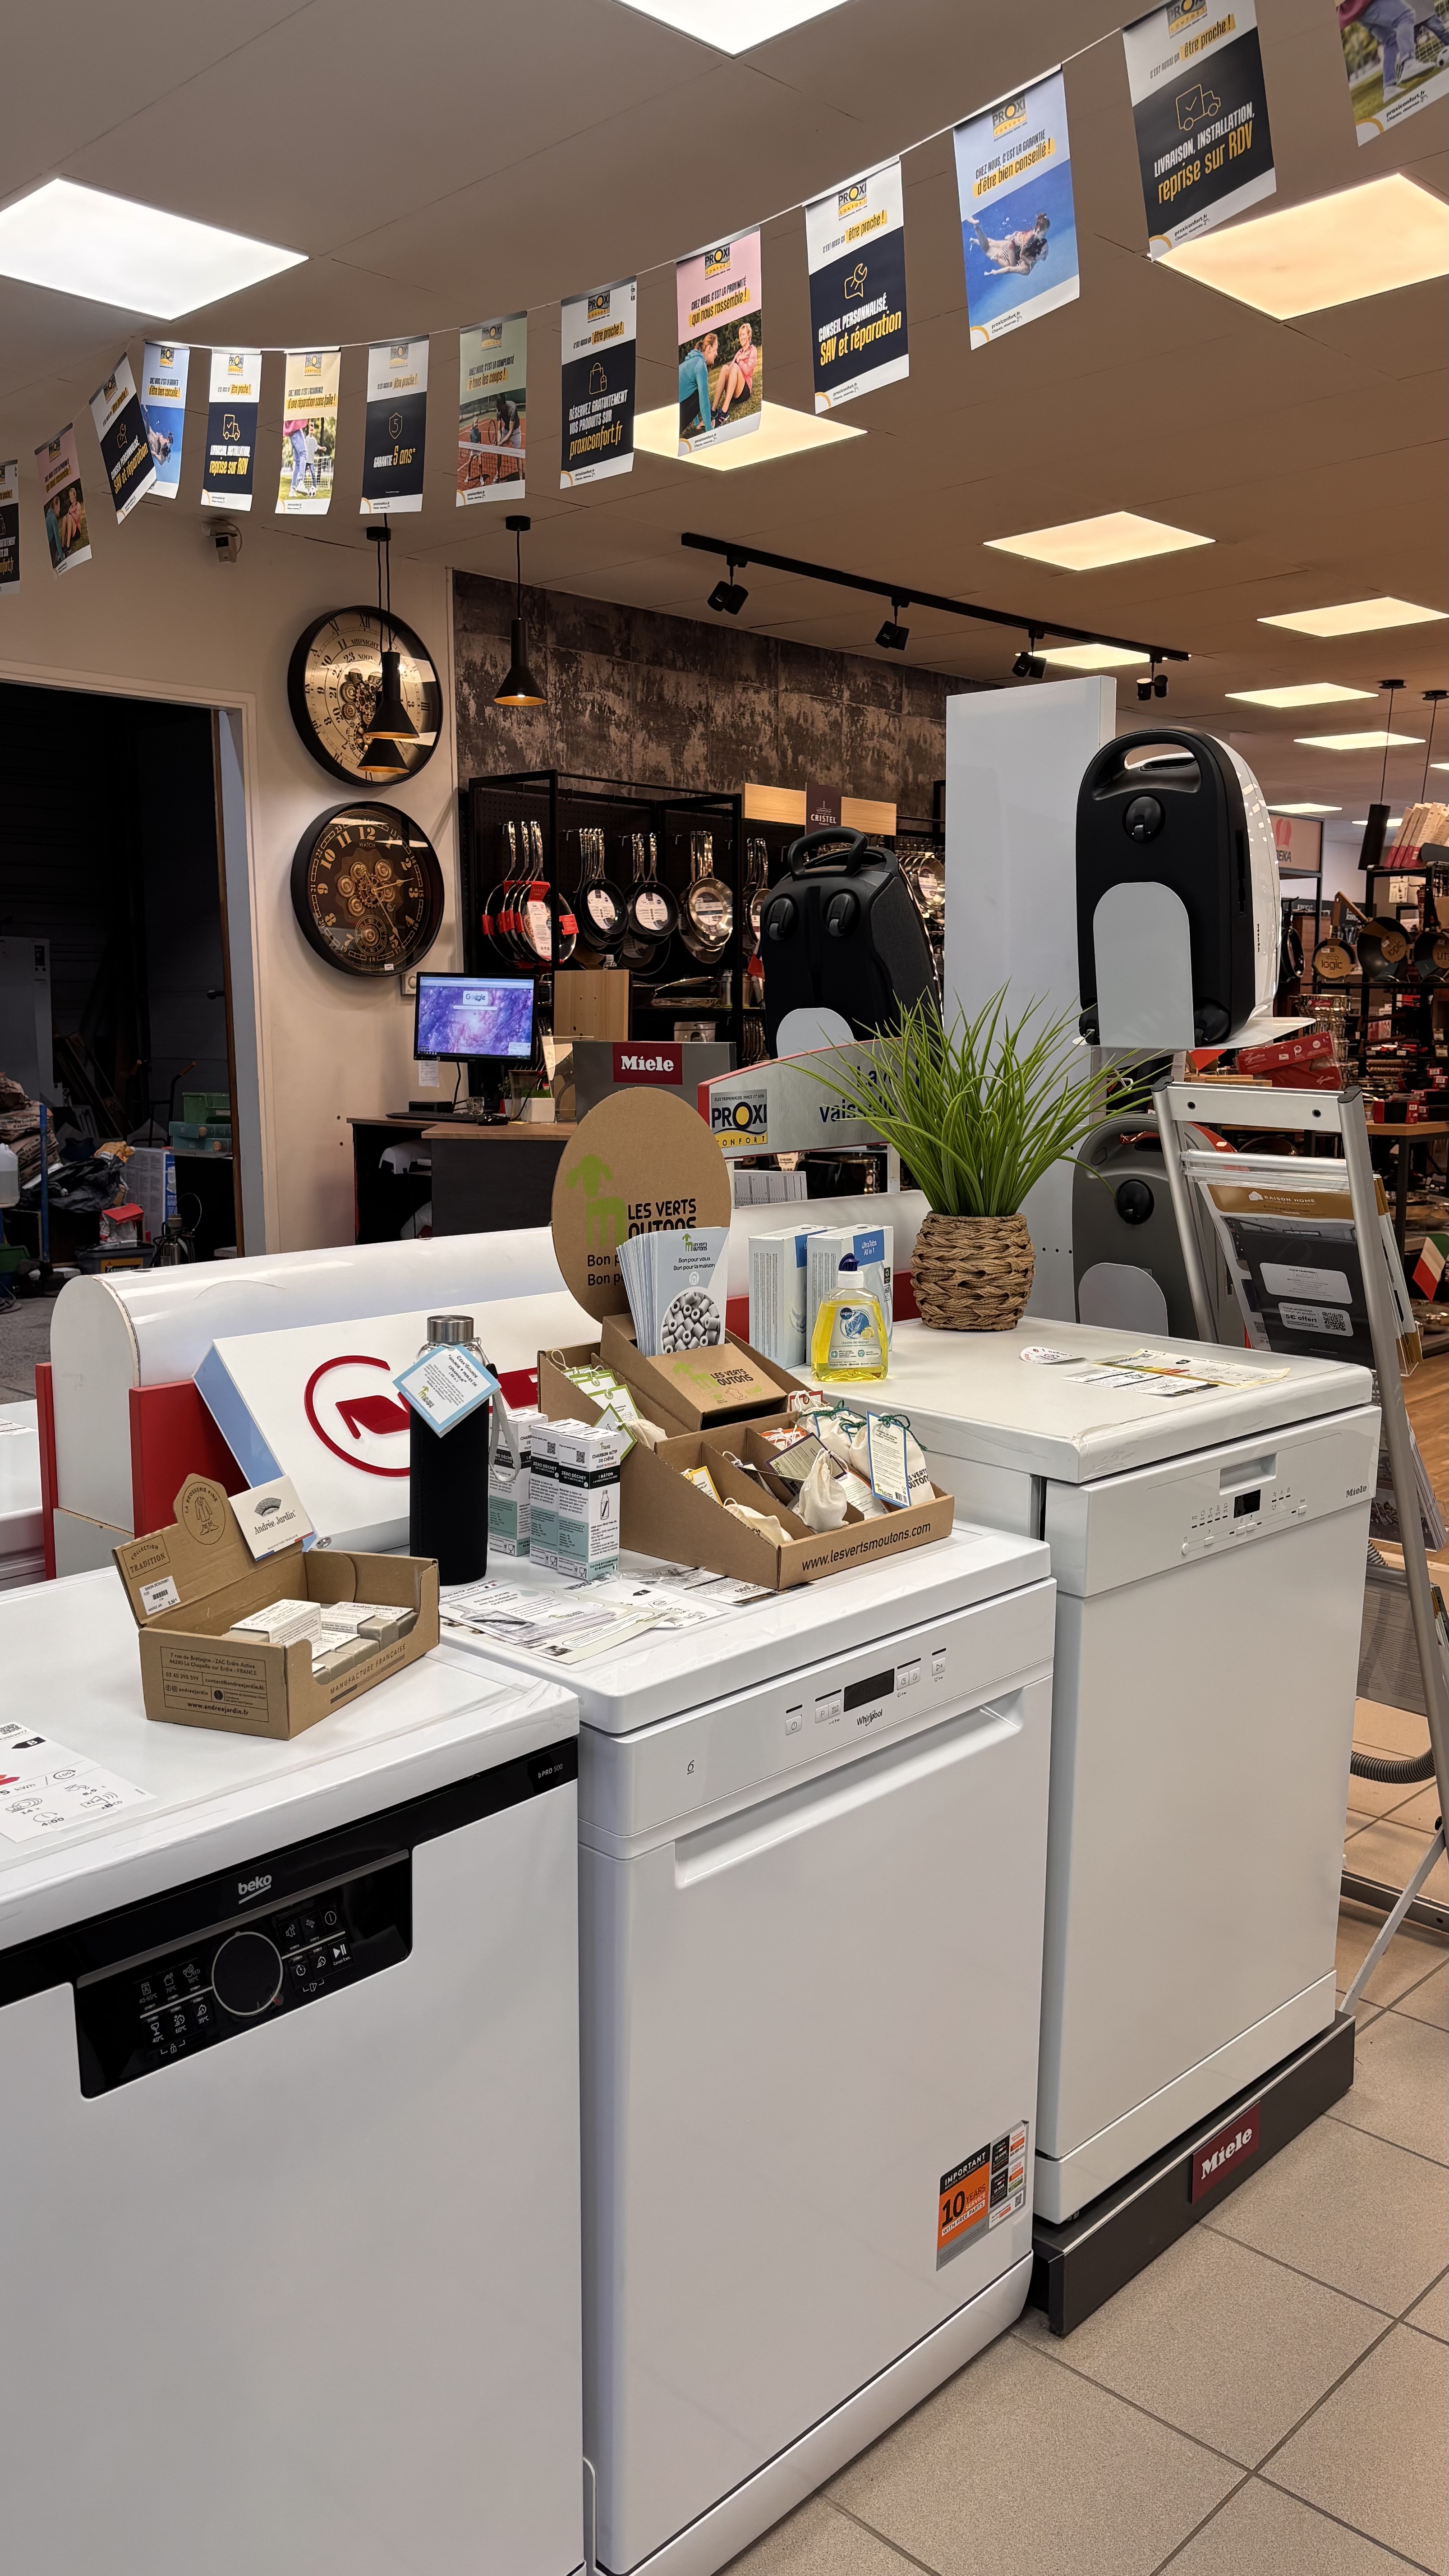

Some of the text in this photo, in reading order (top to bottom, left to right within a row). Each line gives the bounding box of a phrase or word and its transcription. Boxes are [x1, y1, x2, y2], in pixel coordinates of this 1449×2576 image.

[1184, 20, 1226, 58] être proche
[992, 97, 1026, 127] PROXI
[1154, 101, 1255, 178] LIVRAISON, INSTALLATION,
[975, 164, 987, 179] CHEZ
[1003, 147, 1015, 164] C'EST
[1016, 144, 1022, 155] LA
[1023, 129, 1045, 152] GARANTIE
[1158, 120, 1252, 204] reprise sur RDV
[978, 142, 1046, 195] d'être bien conseillé
[838, 181, 867, 207] PROXI
[848, 214, 880, 241] être proche
[705, 247, 730, 267] PROXI
[692, 290, 743, 327] qui nous rassemble
[819, 292, 888, 343] CONSEIL PERSONNALISÉ,
[593, 323, 619, 343] être proche
[820, 310, 902, 366] SAV et réparation
[489, 371, 502, 384] coups
[569, 389, 628, 421] RÉSERVEZ GRATUITEMENT
[570, 409, 612, 435] VOS PRODUITS SUR
[570, 420, 623, 460] proxiconfort.fr
[373, 445, 399, 468] GARANTIE 5
[351, 639, 379, 649] MIDNIGHT
[810, 814, 837, 824] CRISTEL
[336, 830, 353, 849] 11
[358, 826, 376, 841] 12
[320, 848, 336, 870] 10
[1276, 850, 1292, 863] REKA
[1387, 940, 1404, 957] logic
[1321, 959, 1343, 971] logic
[621, 1055, 674, 1072] Miele
[712, 1101, 767, 1130] PROXI
[717, 1136, 765, 1146] ONFORT
[628, 1198, 697, 1220] LES VERTS
[588, 1254, 610, 1267] Bon
[588, 1273, 610, 1286] Bon
[710, 1368, 747, 1380] LES VERTS
[716, 1374, 754, 1386] OUTONS
[1345, 1485, 1367, 1498] Miele
[254, 1510, 296, 1535] Andrée Jardin
[130, 1544, 159, 1560] COLLECTION
[801, 1522, 931, 1572] www.lesvertsmoutons.com
[129, 1552, 166, 1574] TRADITION
[237, 1668, 258, 1676] FRANCE
[330, 1643, 406, 1694] MANUFACTURE FRANÇAISE
[179, 1687, 208, 1696] andreejardin
[187, 1702, 249, 1716] www.andreejardin.fr
[820, 1710, 825, 1718] P
[856, 1708, 883, 1726] Whirlpool
[553, 1763, 563, 1772] 500
[14, 1783, 37, 1791] kWh
[238, 1874, 272, 1895] beko
[1201, 2128, 1253, 2180] Miele
[945, 2151, 986, 2187] IMPORTANT
[942, 2184, 986, 2228] 10 YEARS
[965, 2192, 986, 2211] SERVICE
[943, 2201, 984, 2235] WITH FREE PARTS
